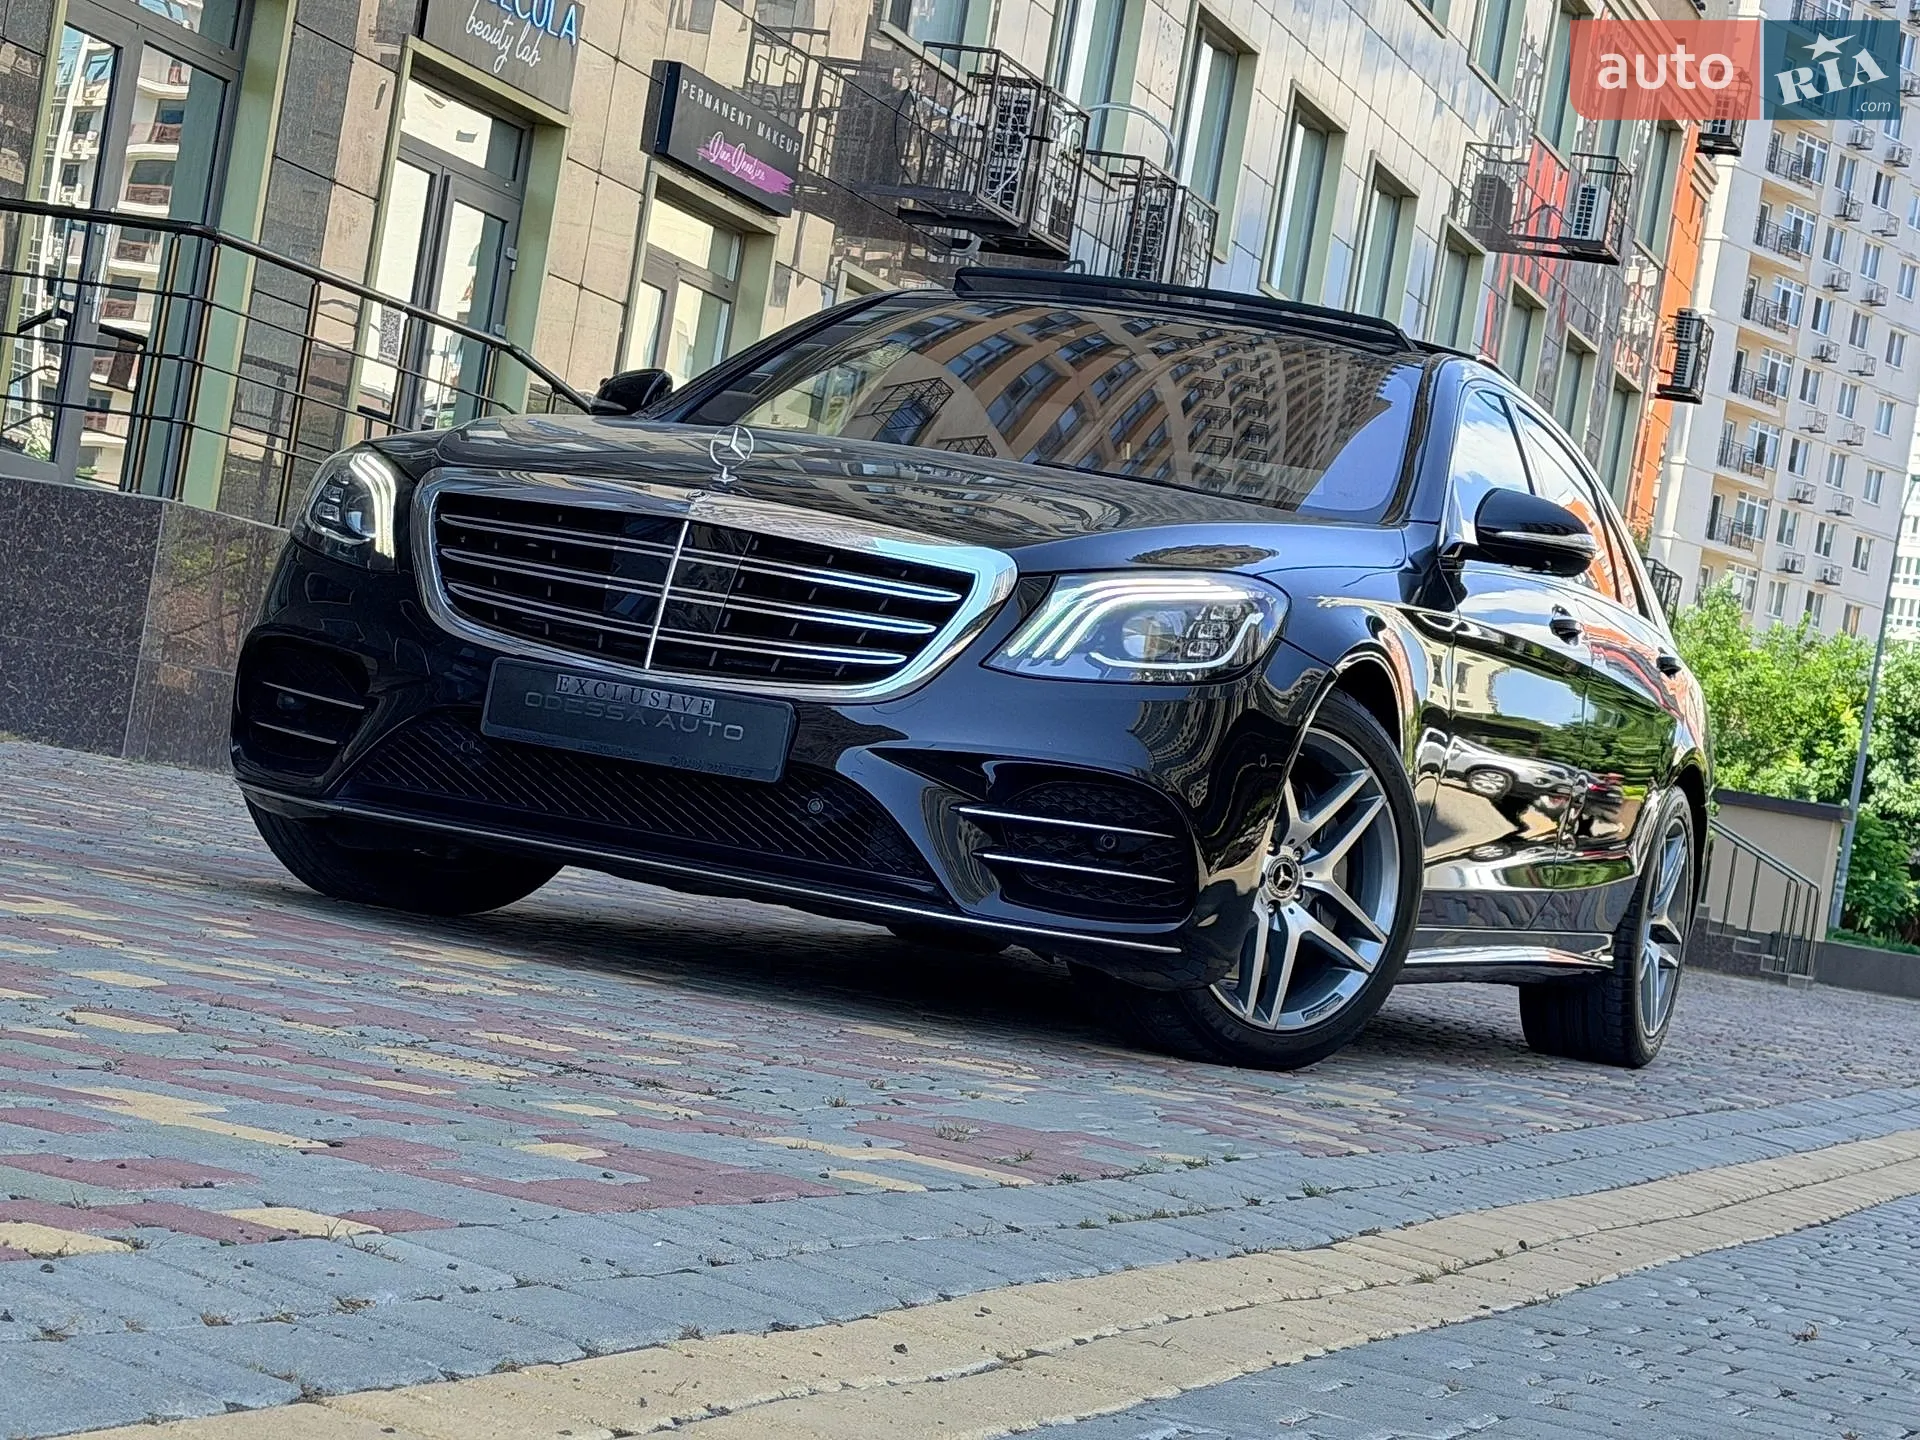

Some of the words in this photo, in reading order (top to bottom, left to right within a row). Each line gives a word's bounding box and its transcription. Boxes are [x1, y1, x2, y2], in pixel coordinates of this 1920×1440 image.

[465, 0, 514, 73] beauty
[515, 20, 545, 67] lab
[486, 0, 577, 46] CULA
[681, 79, 752, 130] PERMANENT
[757, 121, 800, 155] MAKEUP
[525, 691, 647, 725] ODESSA
[655, 713, 744, 741] AUTO
[556, 674, 714, 718] EXCLUSIVE
